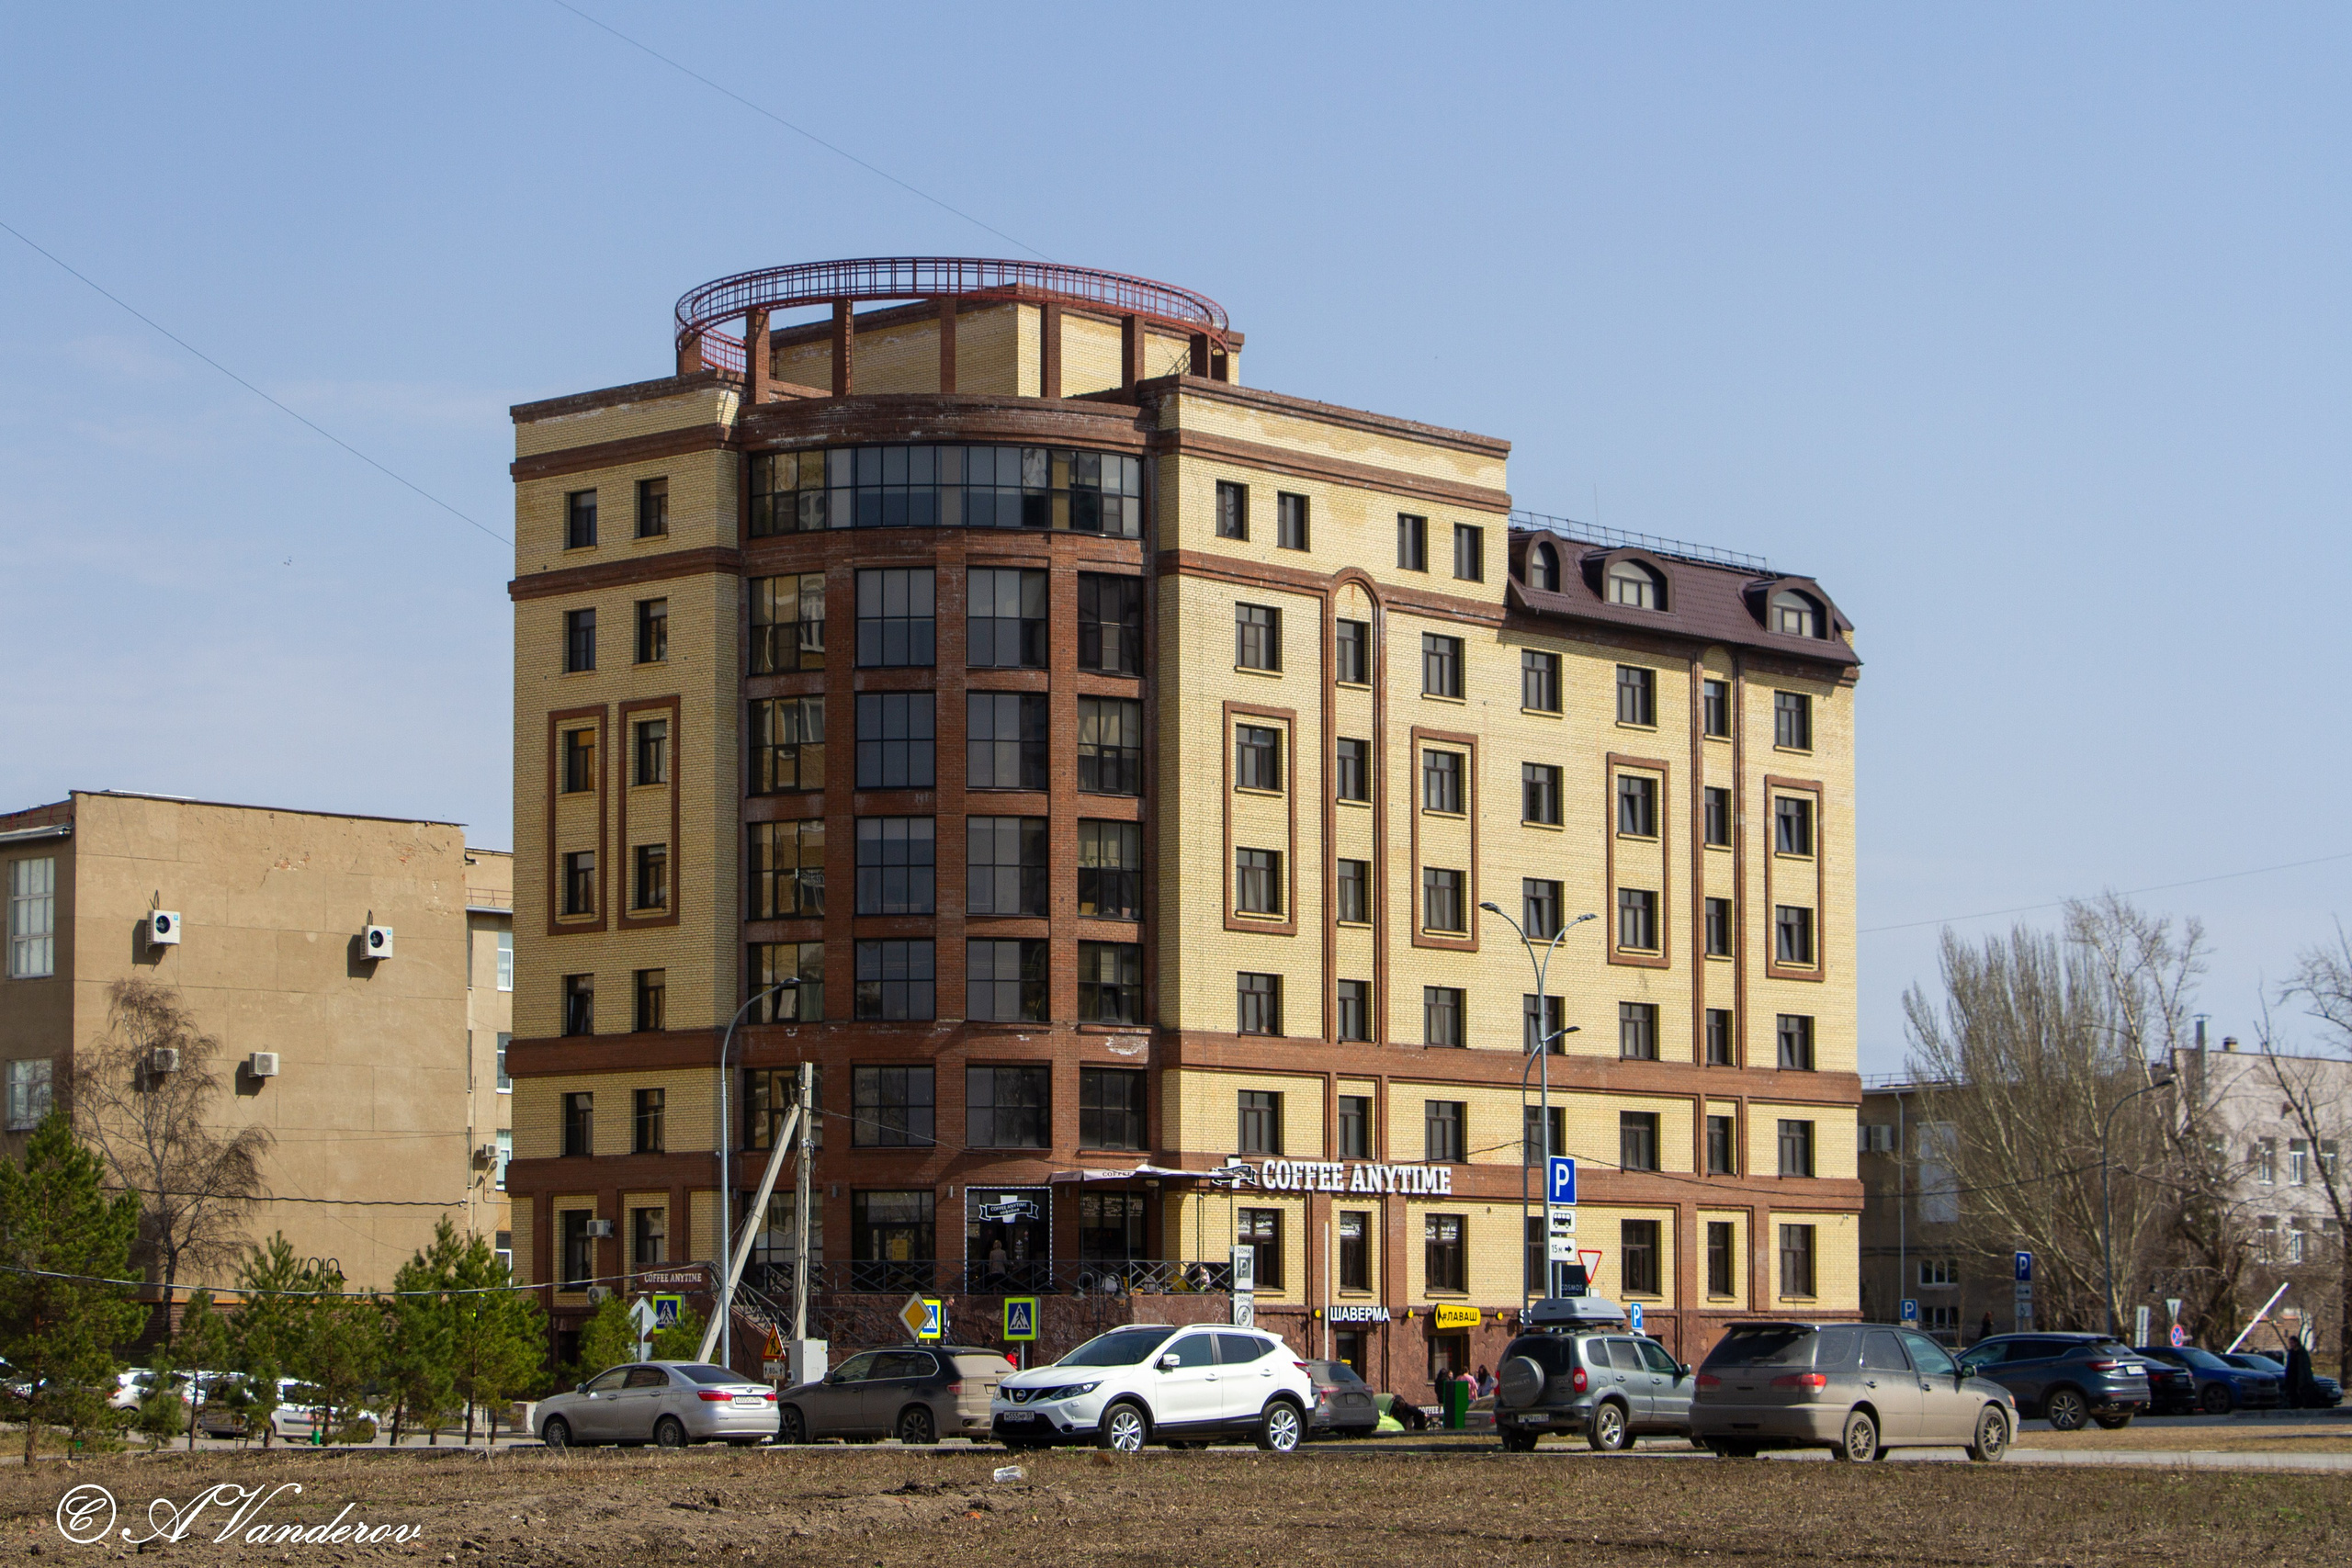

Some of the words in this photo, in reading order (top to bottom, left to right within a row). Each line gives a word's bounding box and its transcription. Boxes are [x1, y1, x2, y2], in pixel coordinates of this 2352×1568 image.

[1261, 1159, 1344, 1192] COFFEE
[1350, 1164, 1452, 1194] ANYTIME
[1555, 1163, 1569, 1197] P
[1239, 1258, 1249, 1277] P
[2018, 1256, 2028, 1277] P
[644, 1273, 669, 1283] COFFEE
[670, 1273, 702, 1283] ANYTIME
[1561, 1283, 1583, 1292] COSMOS
[1329, 1306, 1391, 1322] ШАВЕРМА
[1442, 1309, 1477, 1322] #ЛАВАШ
[1633, 1304, 1641, 1326] P
[1905, 1302, 1914, 1317] P
